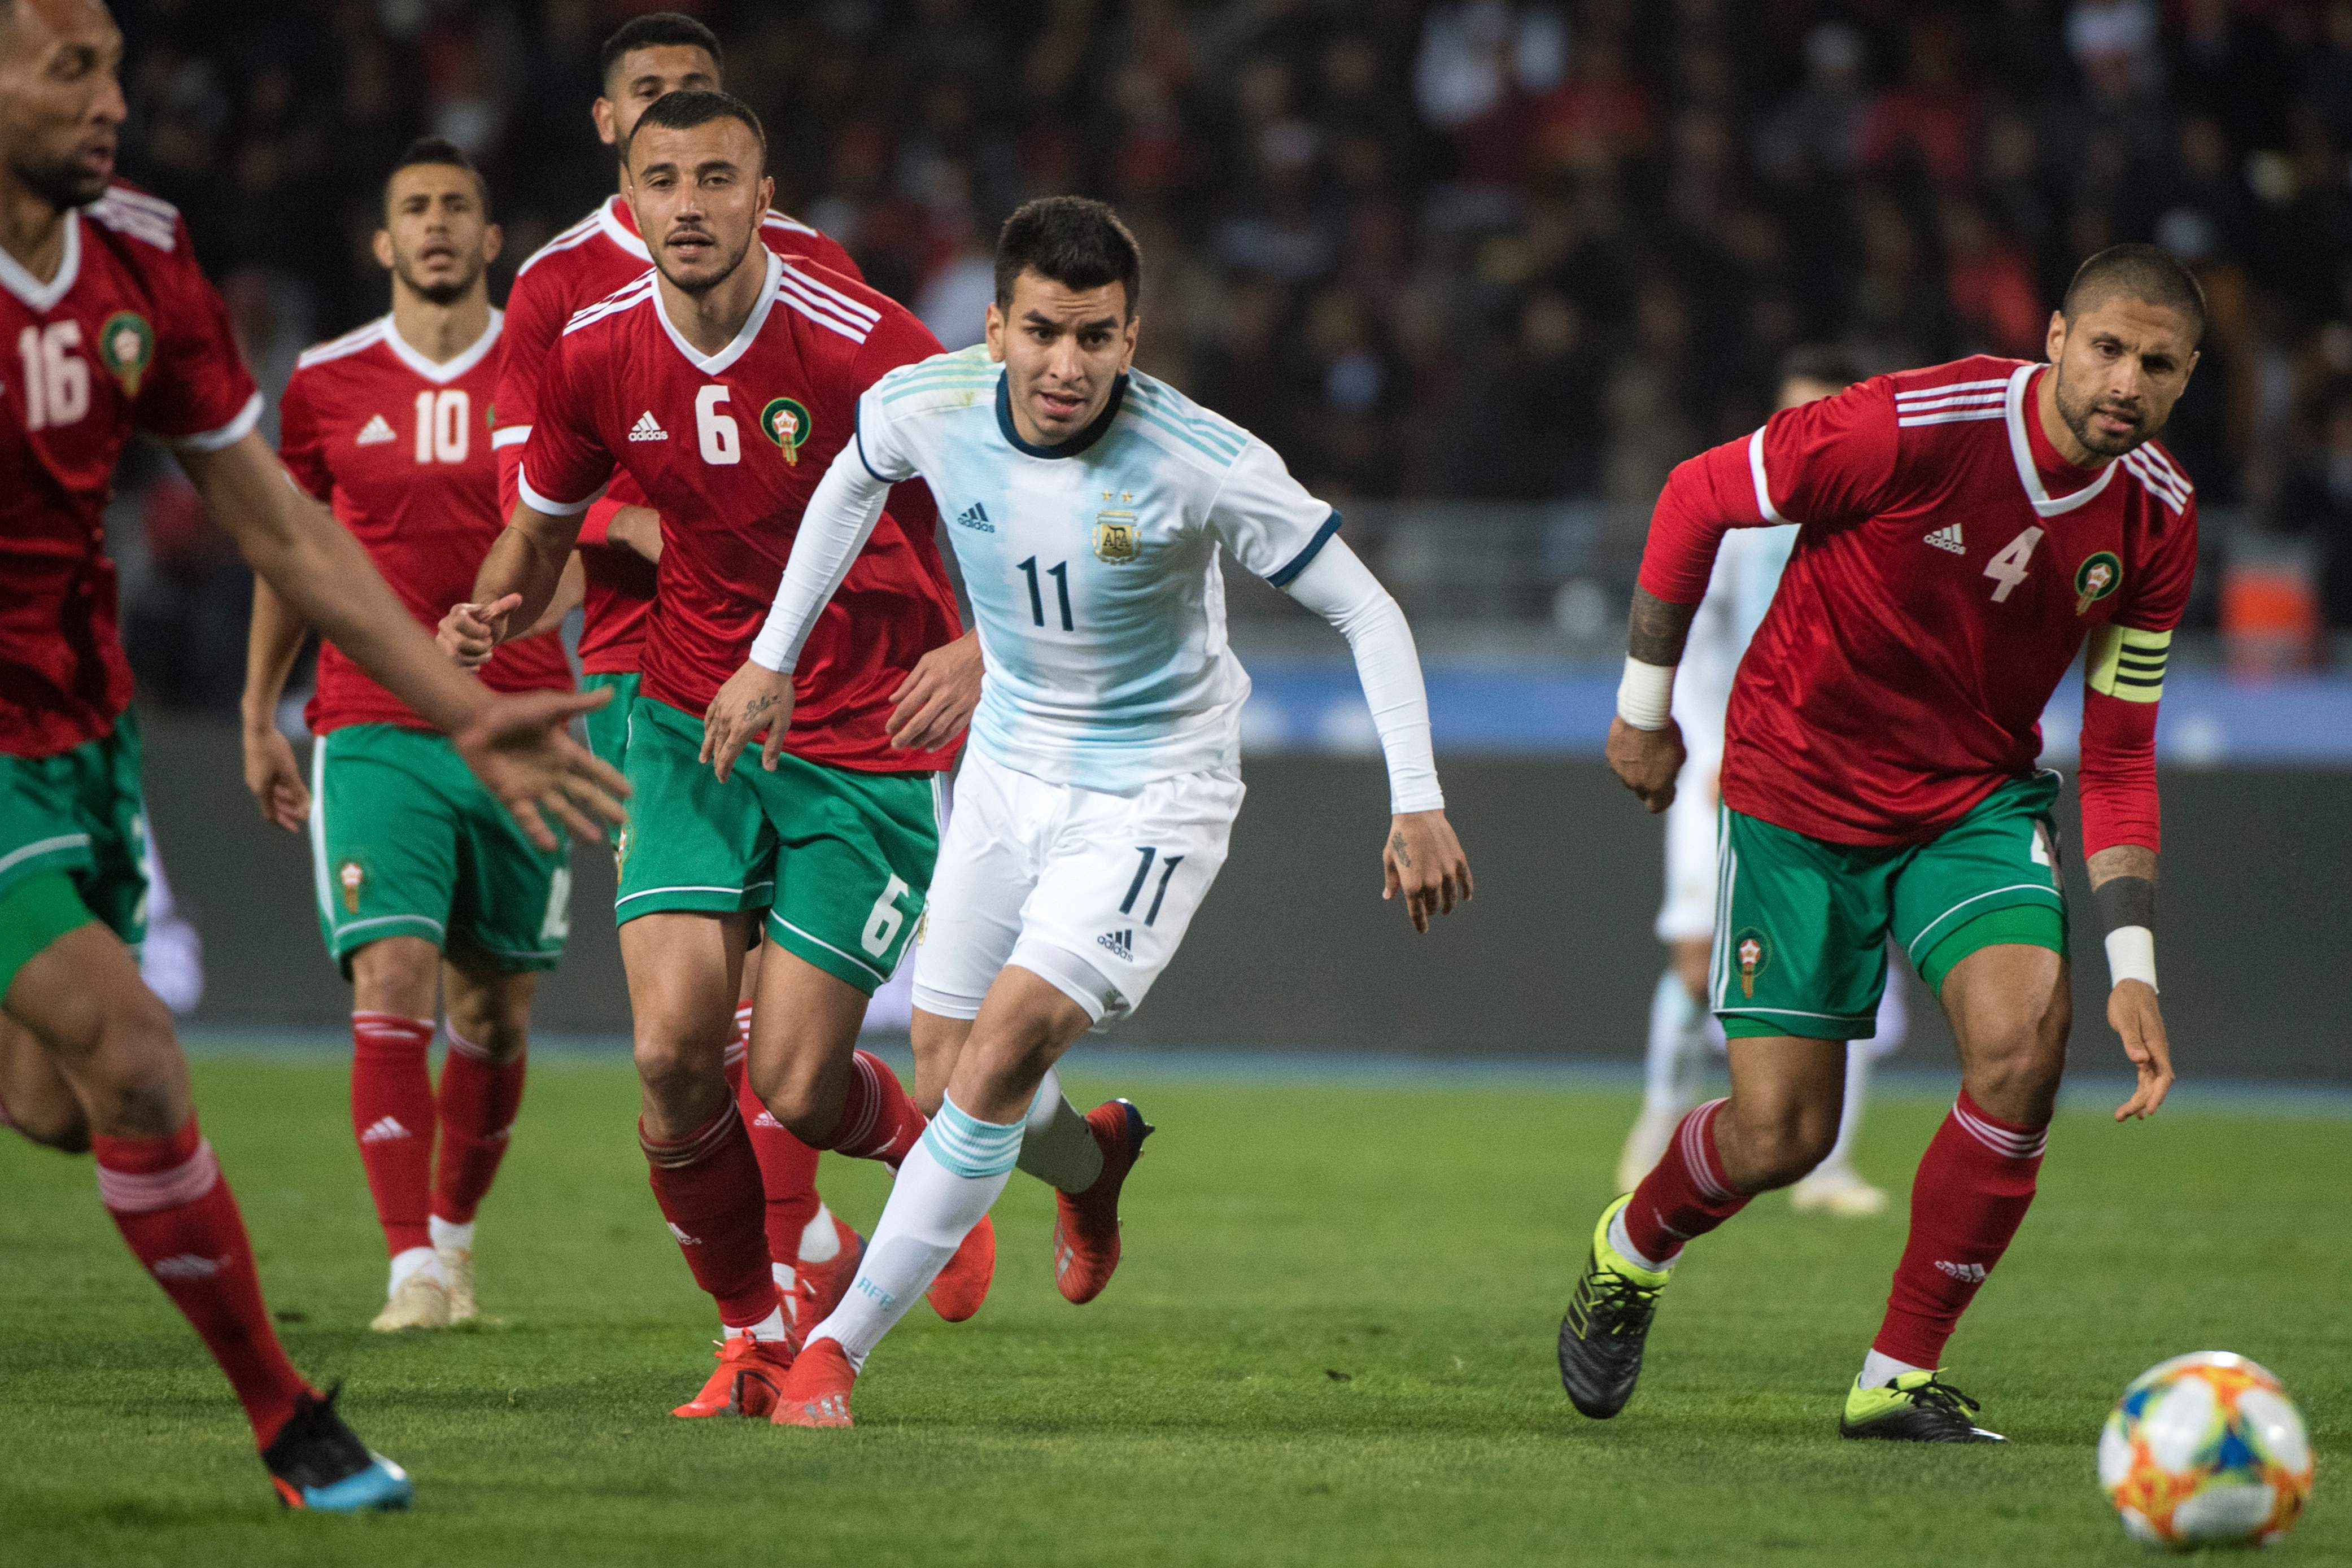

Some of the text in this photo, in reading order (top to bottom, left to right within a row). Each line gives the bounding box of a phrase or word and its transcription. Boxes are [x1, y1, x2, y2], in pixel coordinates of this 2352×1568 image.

[19, 320, 90, 431] 16
[415, 390, 470, 464] 10
[628, 430, 669, 442] adidas
[695, 385, 741, 465] 6
[958, 517, 995, 533] adidas
[1923, 534, 1966, 555] adidas
[1016, 556, 1074, 631] 11
[1983, 526, 2044, 603] 4
[862, 873, 909, 959] 6
[1119, 847, 1185, 927] 11
[1097, 936, 1133, 962] adidas
